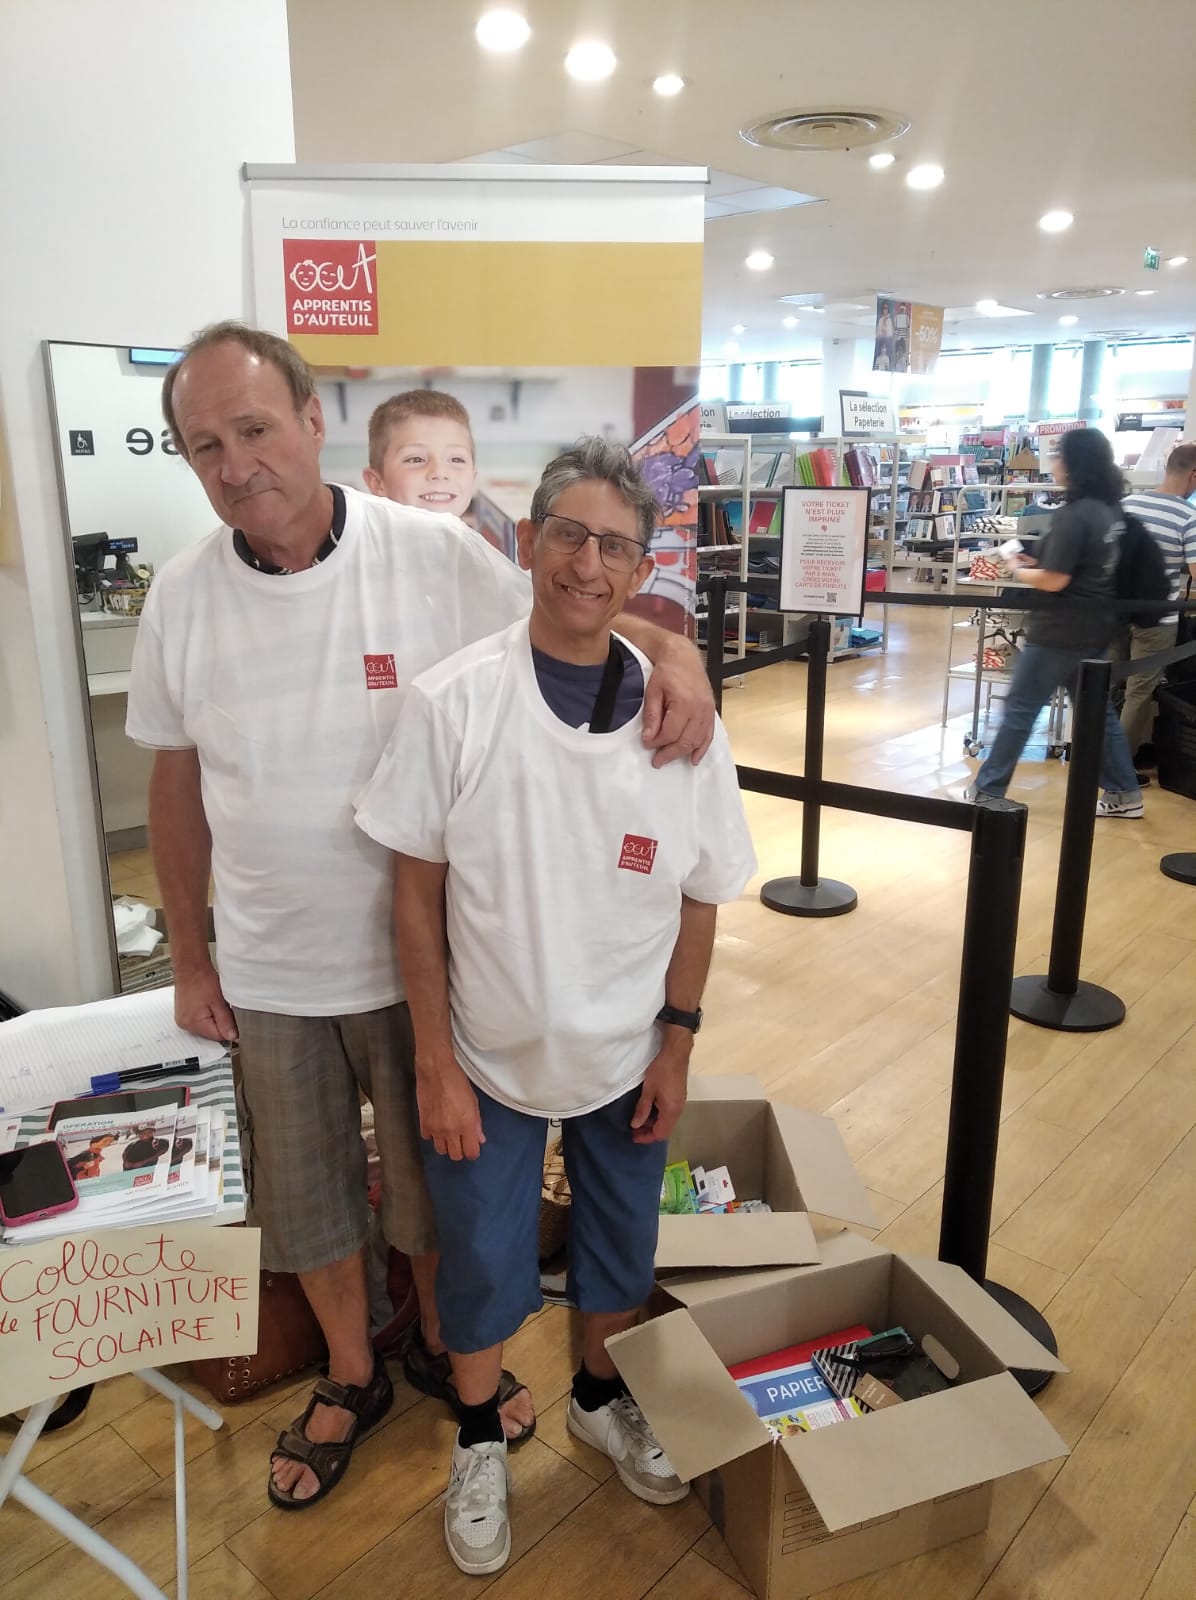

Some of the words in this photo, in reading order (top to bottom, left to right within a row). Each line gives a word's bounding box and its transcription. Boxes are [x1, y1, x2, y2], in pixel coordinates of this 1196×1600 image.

[282, 215, 298, 229] La
[300, 216, 360, 231] confiance
[363, 219, 392, 233] peut
[394, 220, 434, 231] sauver
[437, 218, 479, 232] l'avenir
[292, 299, 372, 312] APPRENTIS
[293, 313, 373, 326] D'AUTEUIL
[915, 325, 938, 344] -50%
[700, 407, 716, 417] ion
[850, 400, 858, 412] La
[859, 401, 887, 413] sélection
[854, 416, 885, 429] Papeterie
[0, 1233, 213, 1303] Collecte
